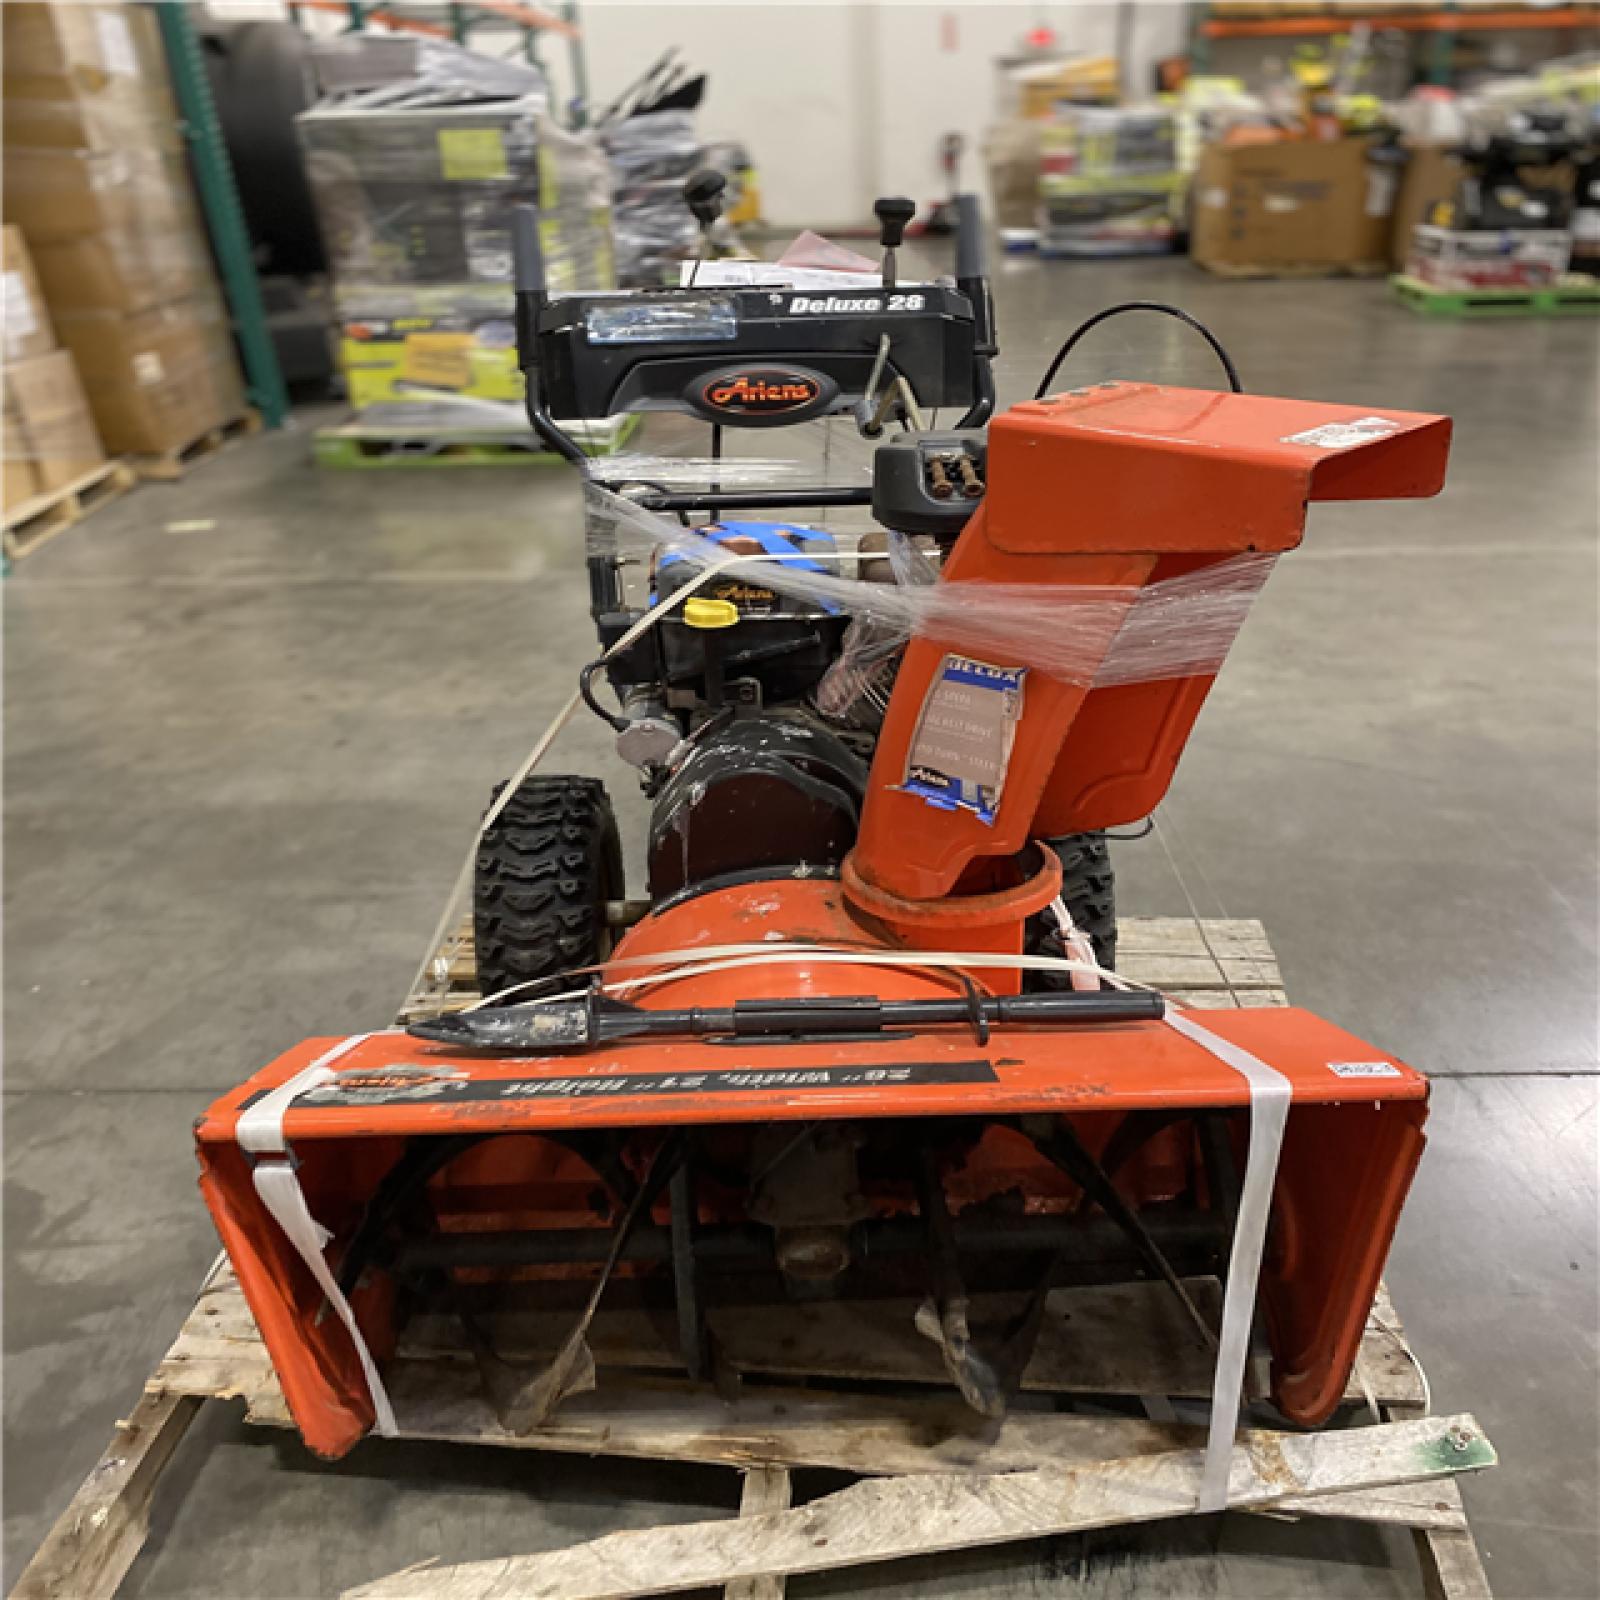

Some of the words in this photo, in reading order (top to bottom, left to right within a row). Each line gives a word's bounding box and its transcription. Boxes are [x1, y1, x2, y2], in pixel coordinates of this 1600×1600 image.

[789, 297, 881, 313] Deluxe
[887, 294, 925, 311] 28
[711, 376, 811, 403] Ariens
